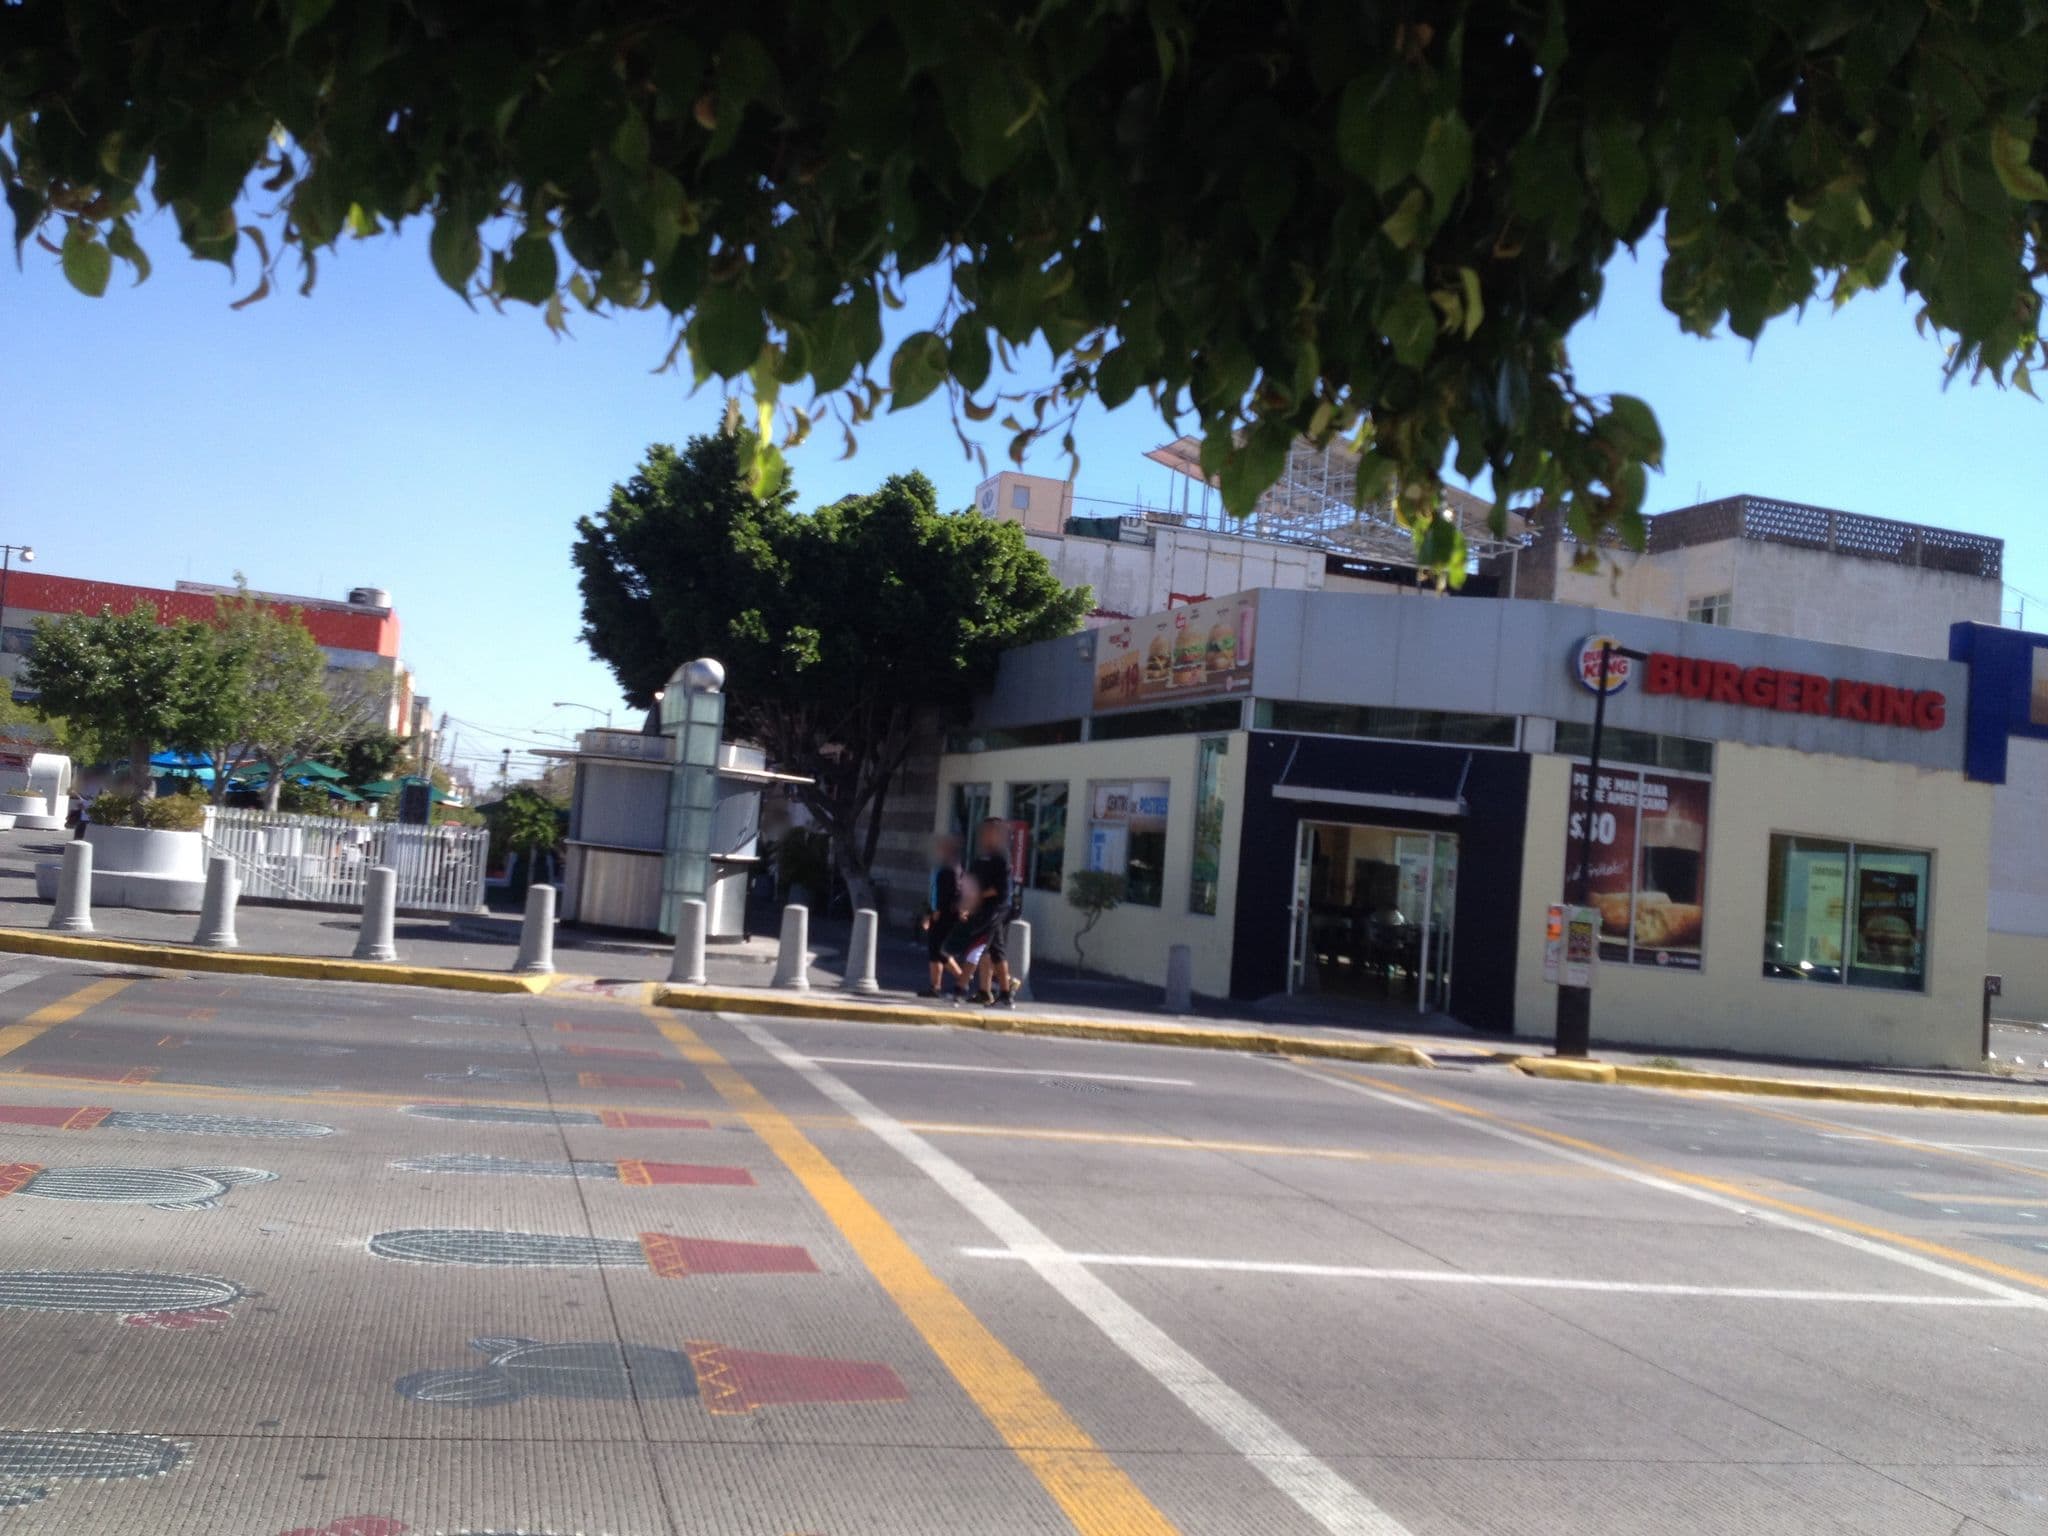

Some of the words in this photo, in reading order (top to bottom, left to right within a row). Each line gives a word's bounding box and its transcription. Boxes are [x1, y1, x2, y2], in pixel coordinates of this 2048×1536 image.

[1645, 652, 1830, 716] BURGER
[1834, 678, 1947, 732] KING
[1573, 772, 1591, 786] PA
